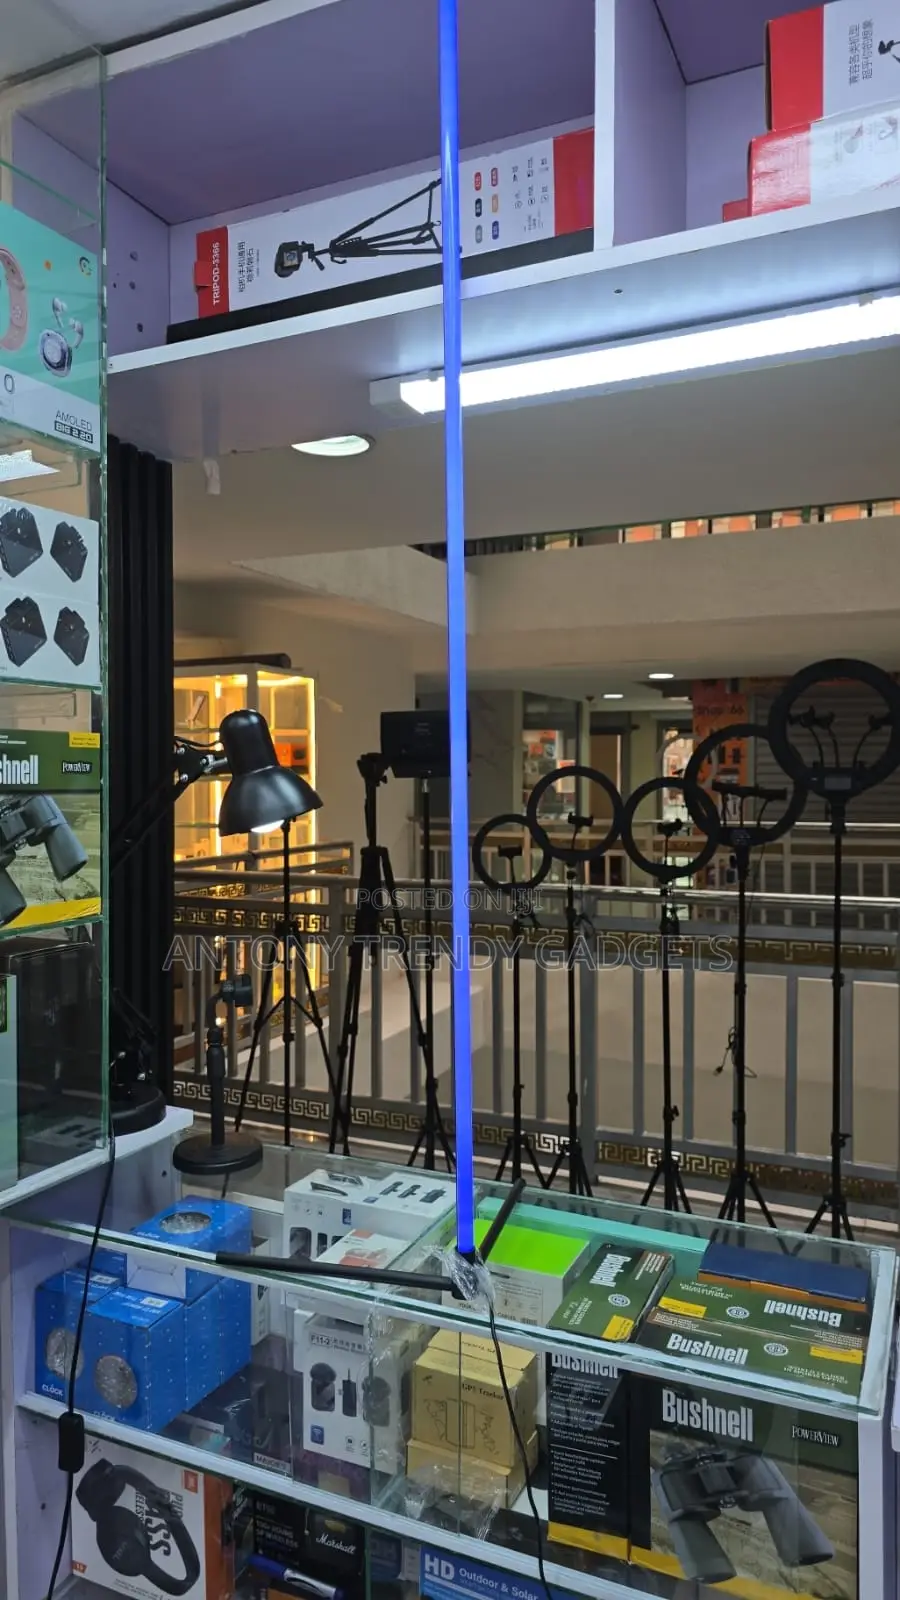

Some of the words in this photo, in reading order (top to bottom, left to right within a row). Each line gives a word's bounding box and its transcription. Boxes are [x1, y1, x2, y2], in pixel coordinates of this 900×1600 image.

[55, 410, 92, 432] AMOLED
[0, 753, 39, 785] hnell
[763, 1299, 843, 1329] Bushnell
[666, 1332, 750, 1365] Bushnell
[662, 1389, 754, 1442] Bushnell
[316, 1533, 357, 1555] Marshall
[424, 1553, 455, 1580] HD
[459, 1567, 499, 1590] Outdoor
[501, 1583, 510, 1593] &
[511, 1585, 540, 1600] Solar
